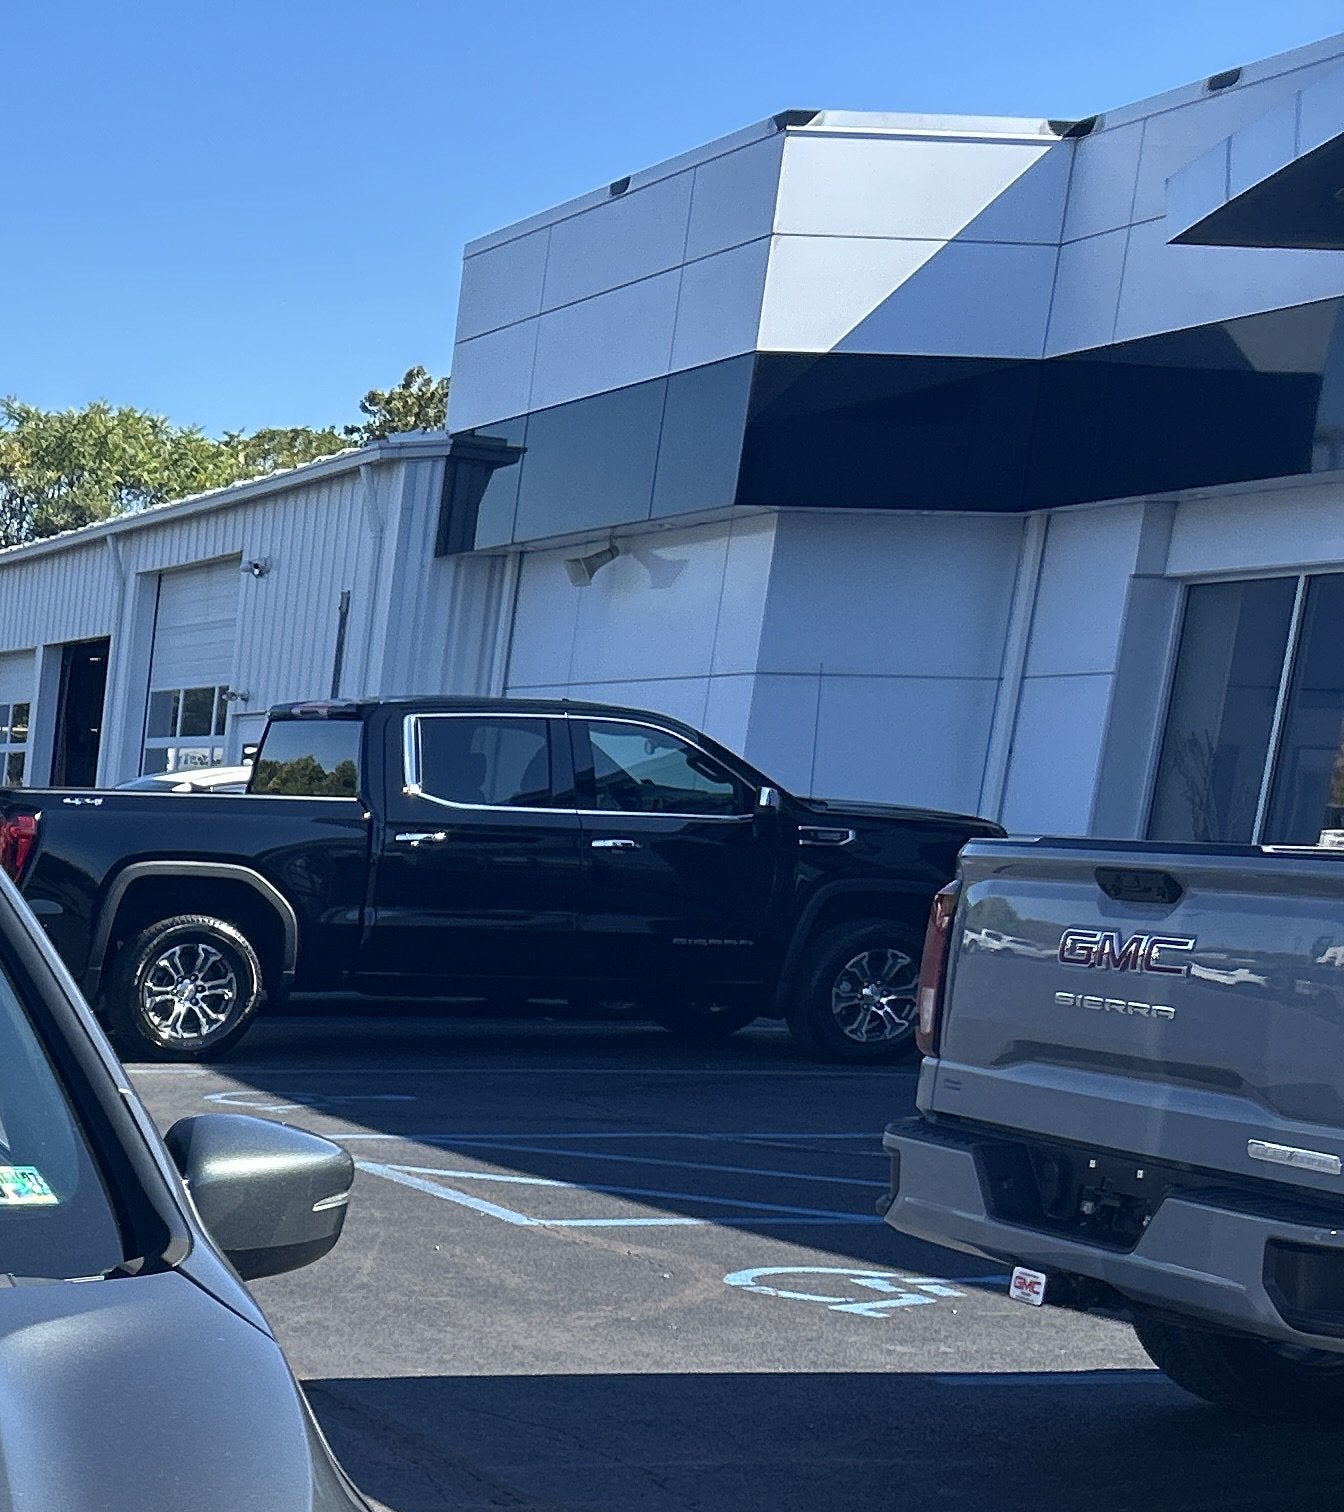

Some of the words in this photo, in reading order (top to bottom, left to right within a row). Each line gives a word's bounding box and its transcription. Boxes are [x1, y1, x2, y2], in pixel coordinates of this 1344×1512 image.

[1058, 928, 1196, 977] GMC
[1054, 991, 1176, 1021] SIERRA
[1014, 1275, 1042, 1295] GMC
